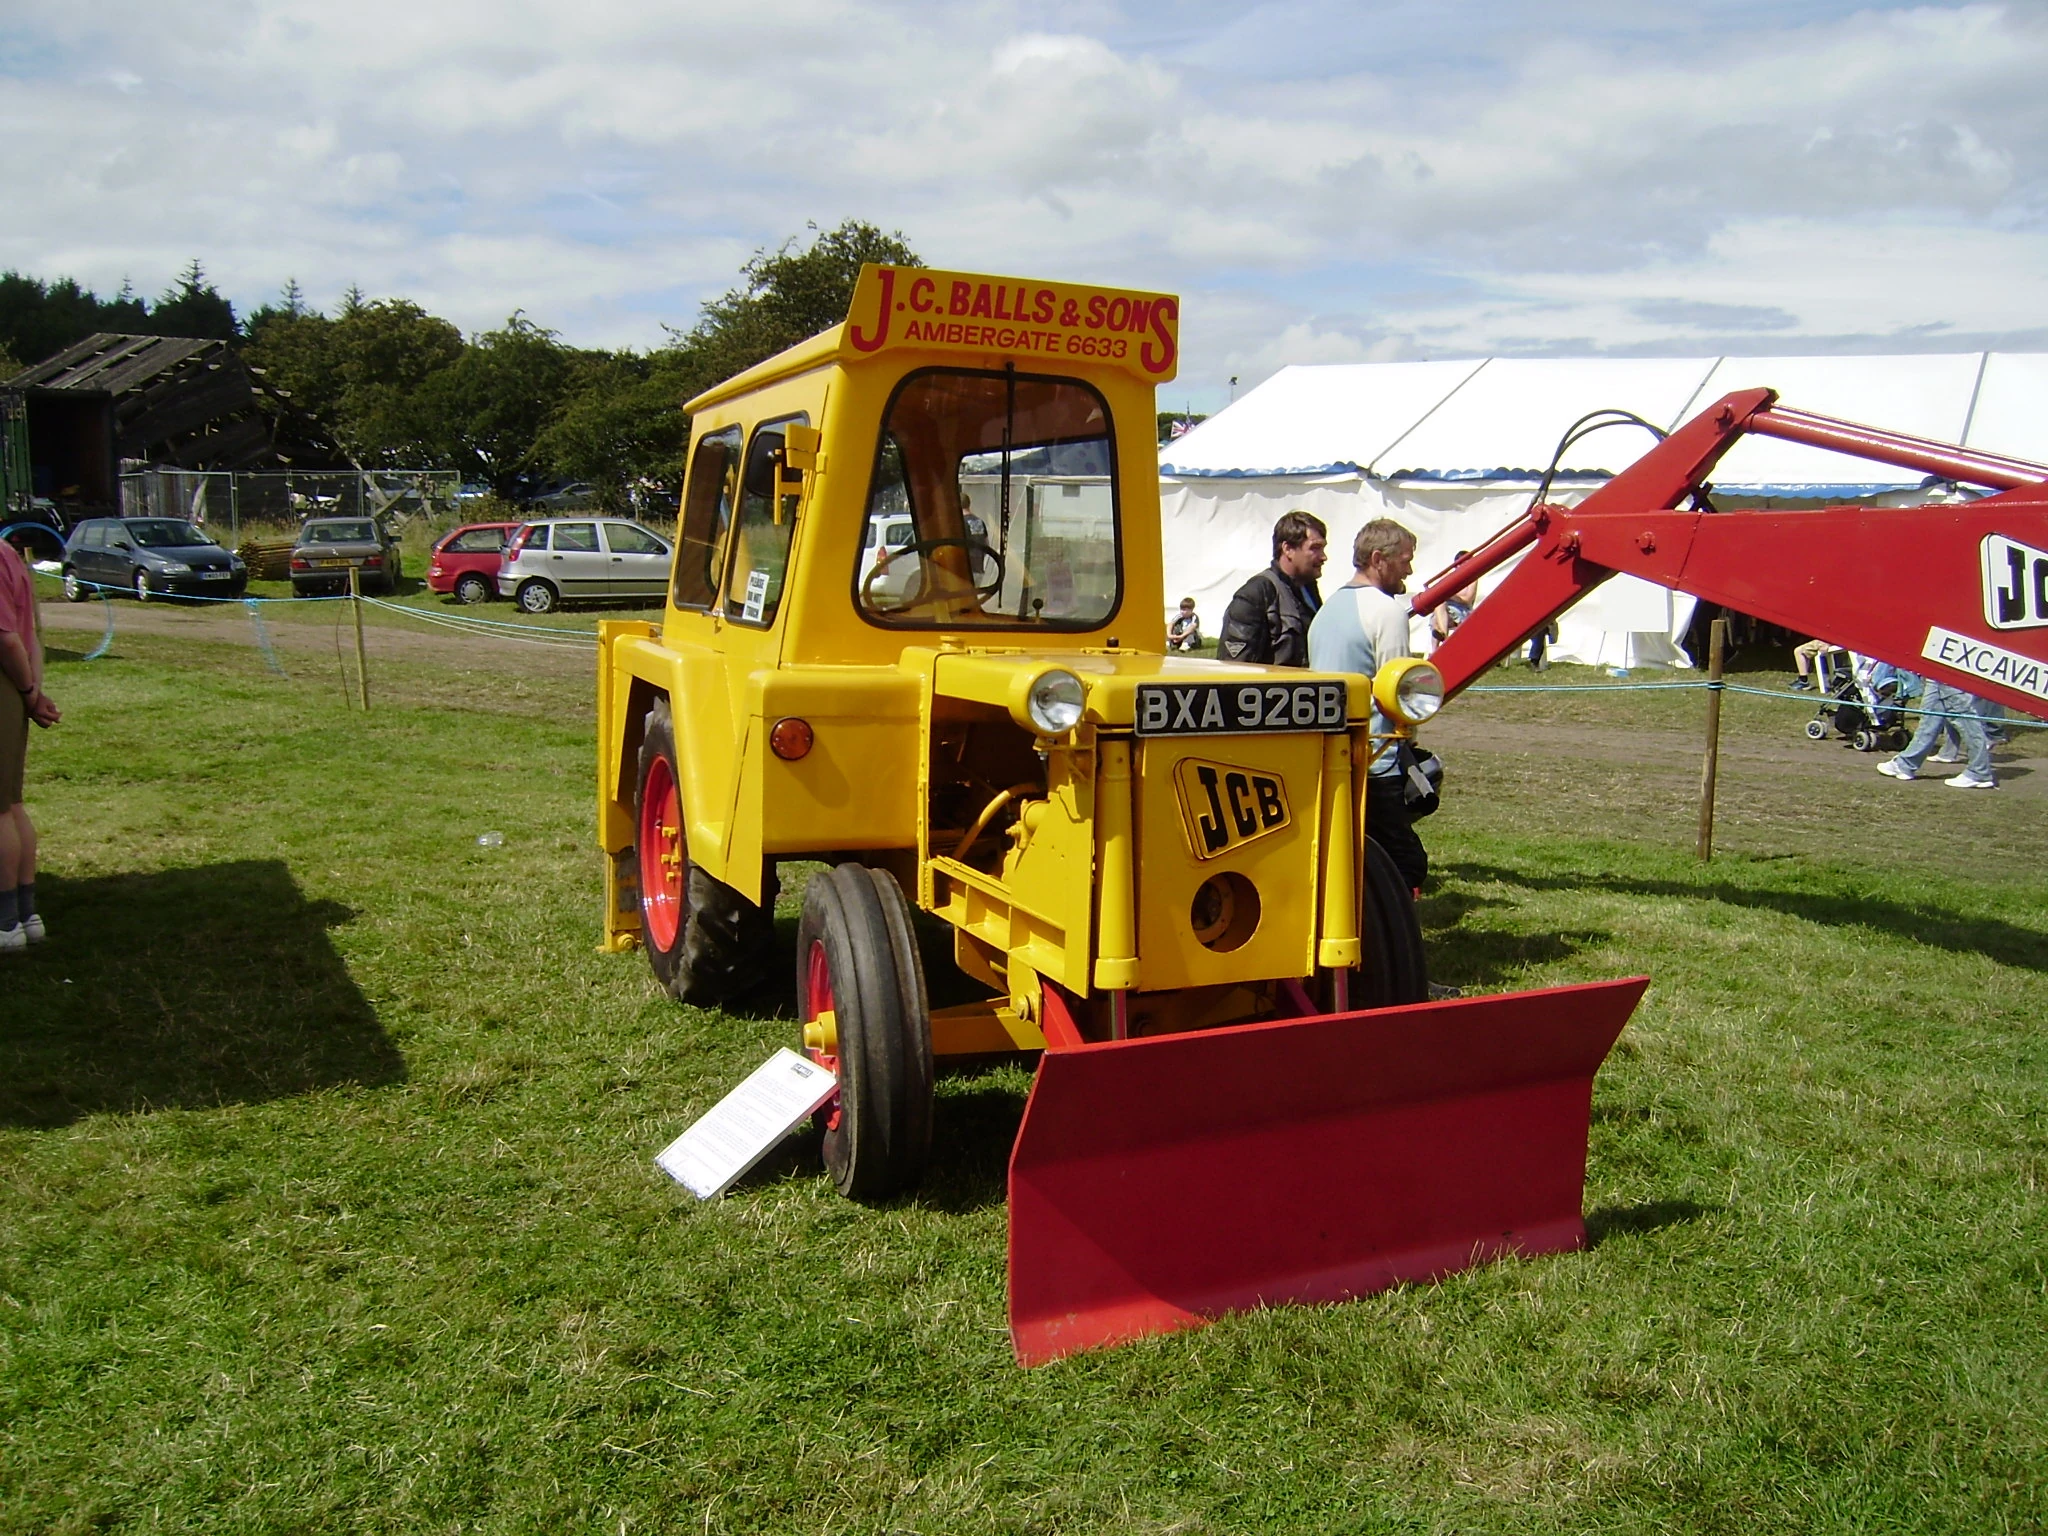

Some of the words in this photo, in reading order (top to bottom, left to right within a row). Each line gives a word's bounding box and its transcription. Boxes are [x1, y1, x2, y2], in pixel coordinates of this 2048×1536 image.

[904, 320, 1061, 352] AMBERGATE
[1066, 335, 1128, 358] 6633
[949, 281, 1056, 323] BALLS
[1059, 298, 1080, 326] &
[1085, 295, 1178, 374] SONS
[1142, 689, 1225, 729] BXA
[1237, 686, 1341, 726] 926B
[1197, 766, 1284, 852] JCB
